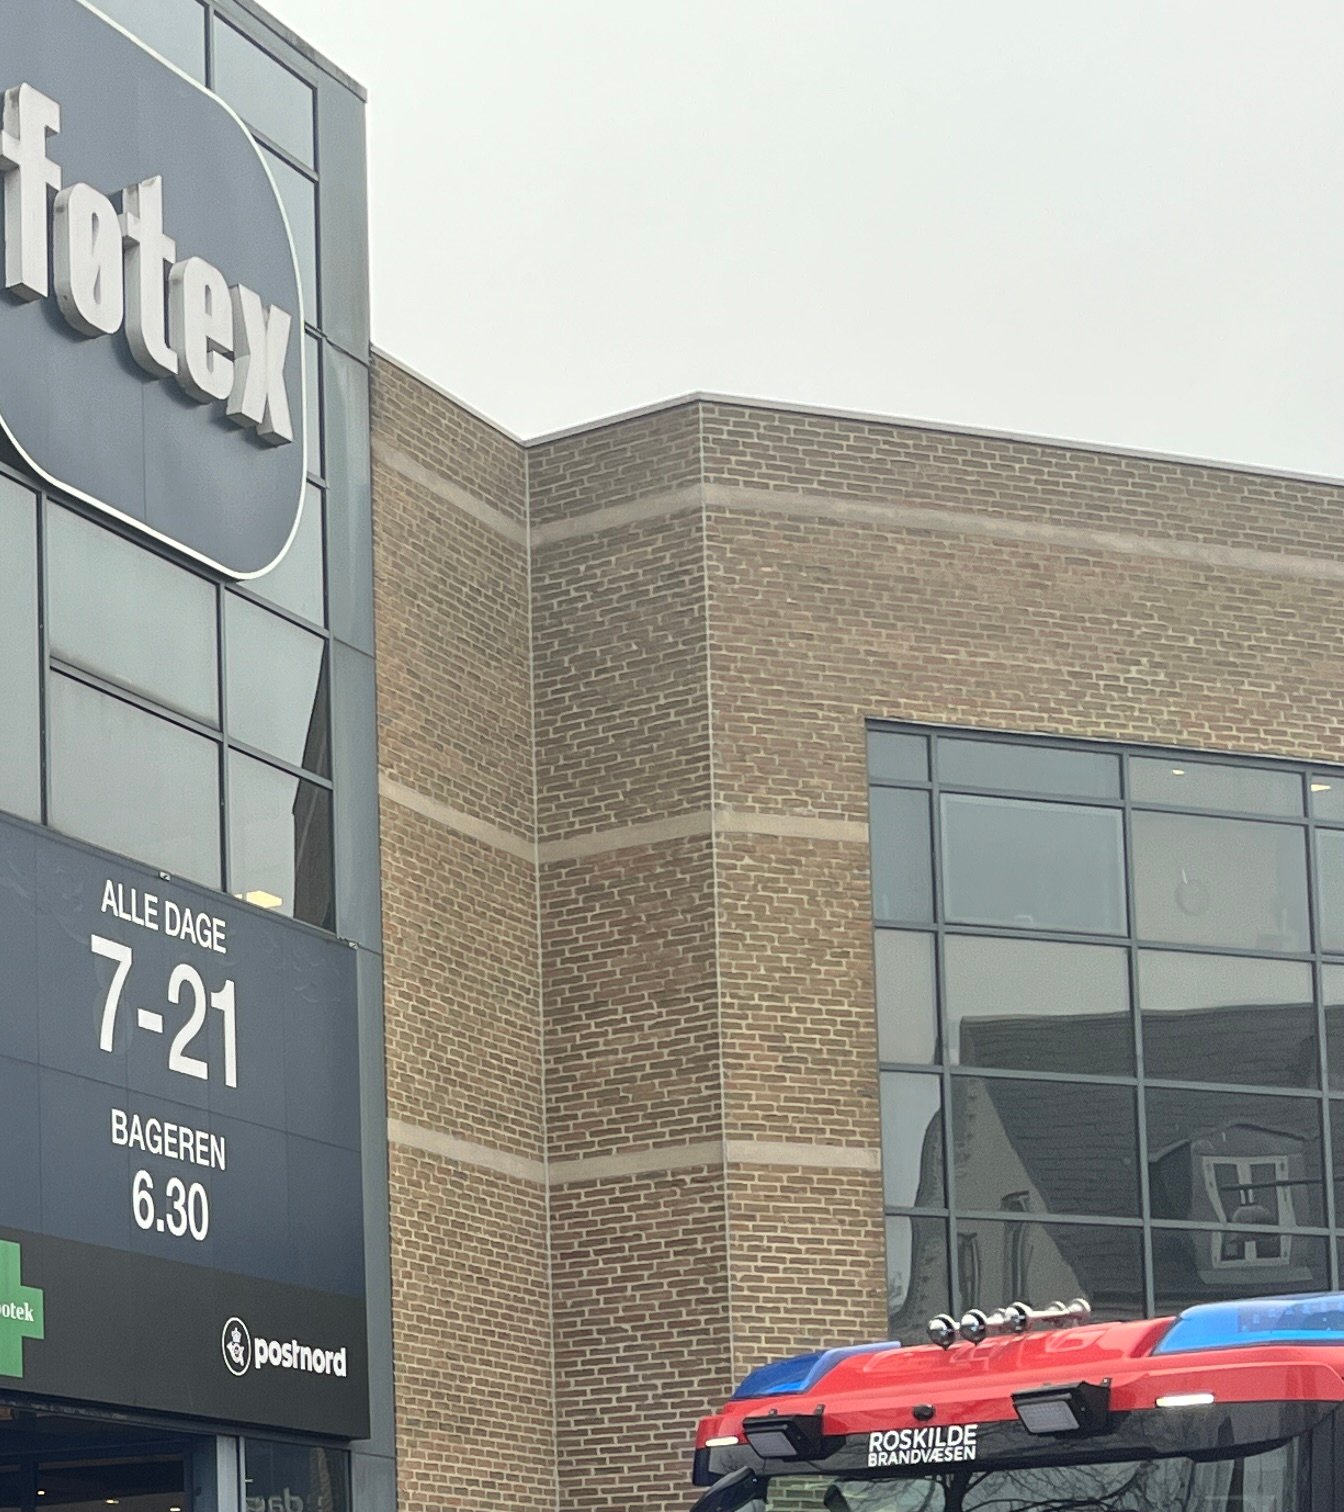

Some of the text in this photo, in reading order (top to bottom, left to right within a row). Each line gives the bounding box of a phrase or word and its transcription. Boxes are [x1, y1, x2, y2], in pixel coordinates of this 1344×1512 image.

[100, 879, 227, 954] ALLE DAGE
[90, 933, 237, 1088] 7-21
[111, 1107, 226, 1171] BAGEREN
[132, 1169, 209, 1242] 6.30
[254, 1336, 347, 1377] postnord
[867, 1445, 977, 1467] BRANDVÆSEN
[868, 1423, 979, 1452] ROSKILDE
